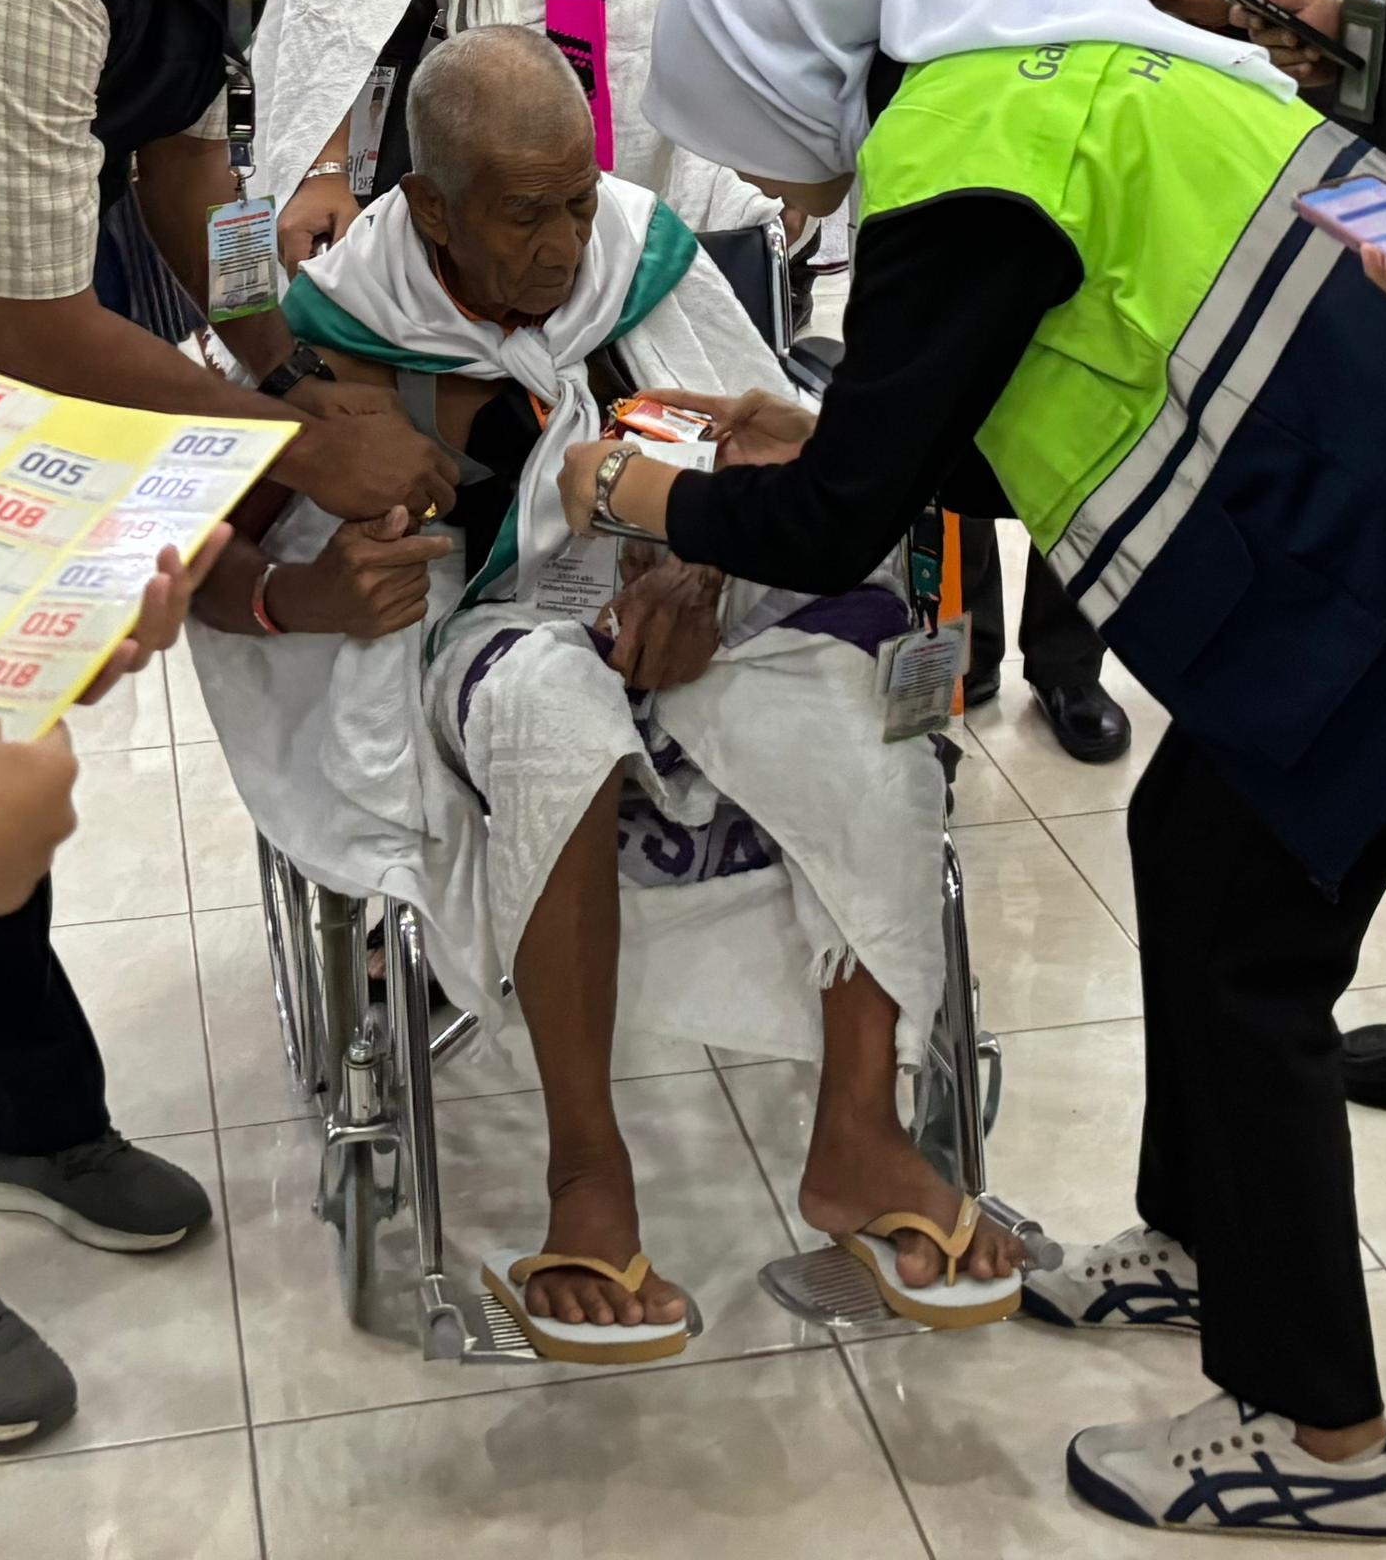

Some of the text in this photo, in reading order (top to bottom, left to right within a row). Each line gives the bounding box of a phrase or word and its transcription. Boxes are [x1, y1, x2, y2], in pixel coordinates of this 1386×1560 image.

[172, 434, 238, 457] 003
[18, 451, 91, 486] 005
[58, 564, 115, 588] 012
[20, 611, 84, 637] 015
